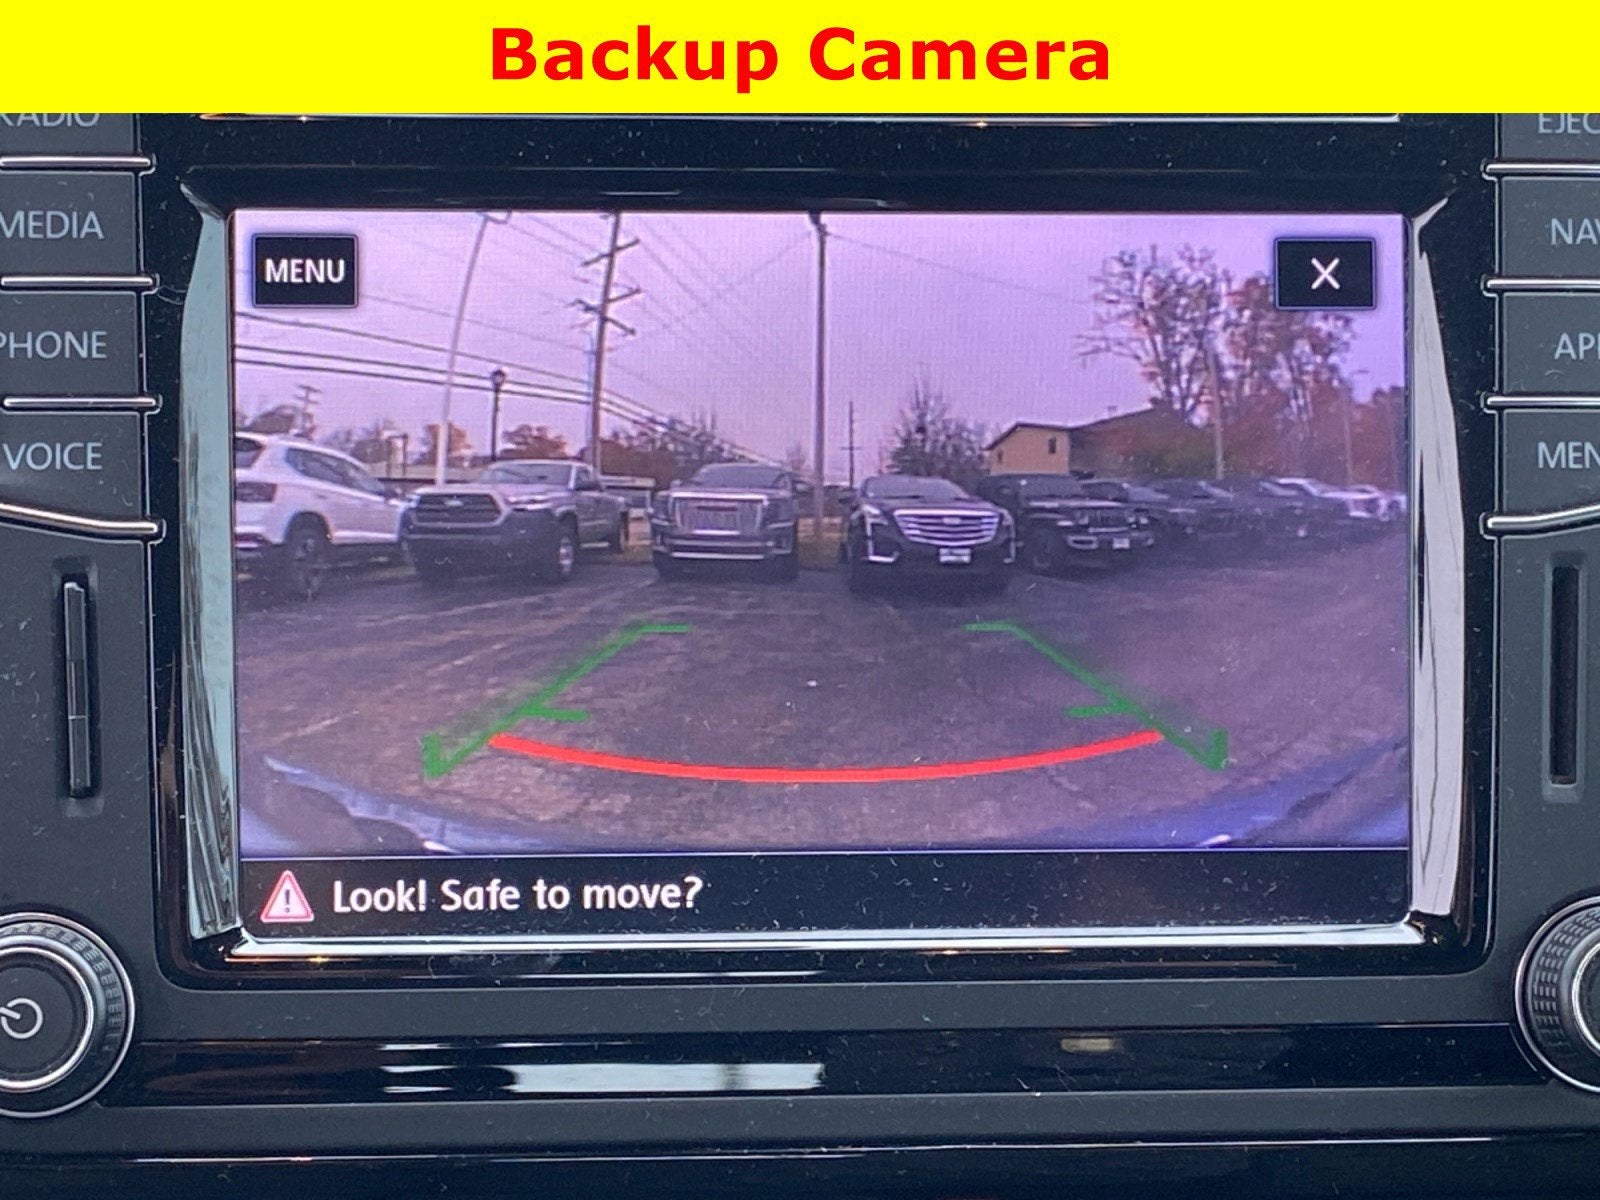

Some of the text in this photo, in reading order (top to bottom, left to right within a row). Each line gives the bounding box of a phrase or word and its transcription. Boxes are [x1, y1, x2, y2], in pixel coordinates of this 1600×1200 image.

[0, 210, 104, 240] MEDIA
[1551, 217, 1600, 245] NA
[264, 257, 346, 284] MENU
[1554, 332, 1600, 360] AP
[2, 441, 102, 471] VOICE
[333, 875, 705, 914] Look! Safe to move?
